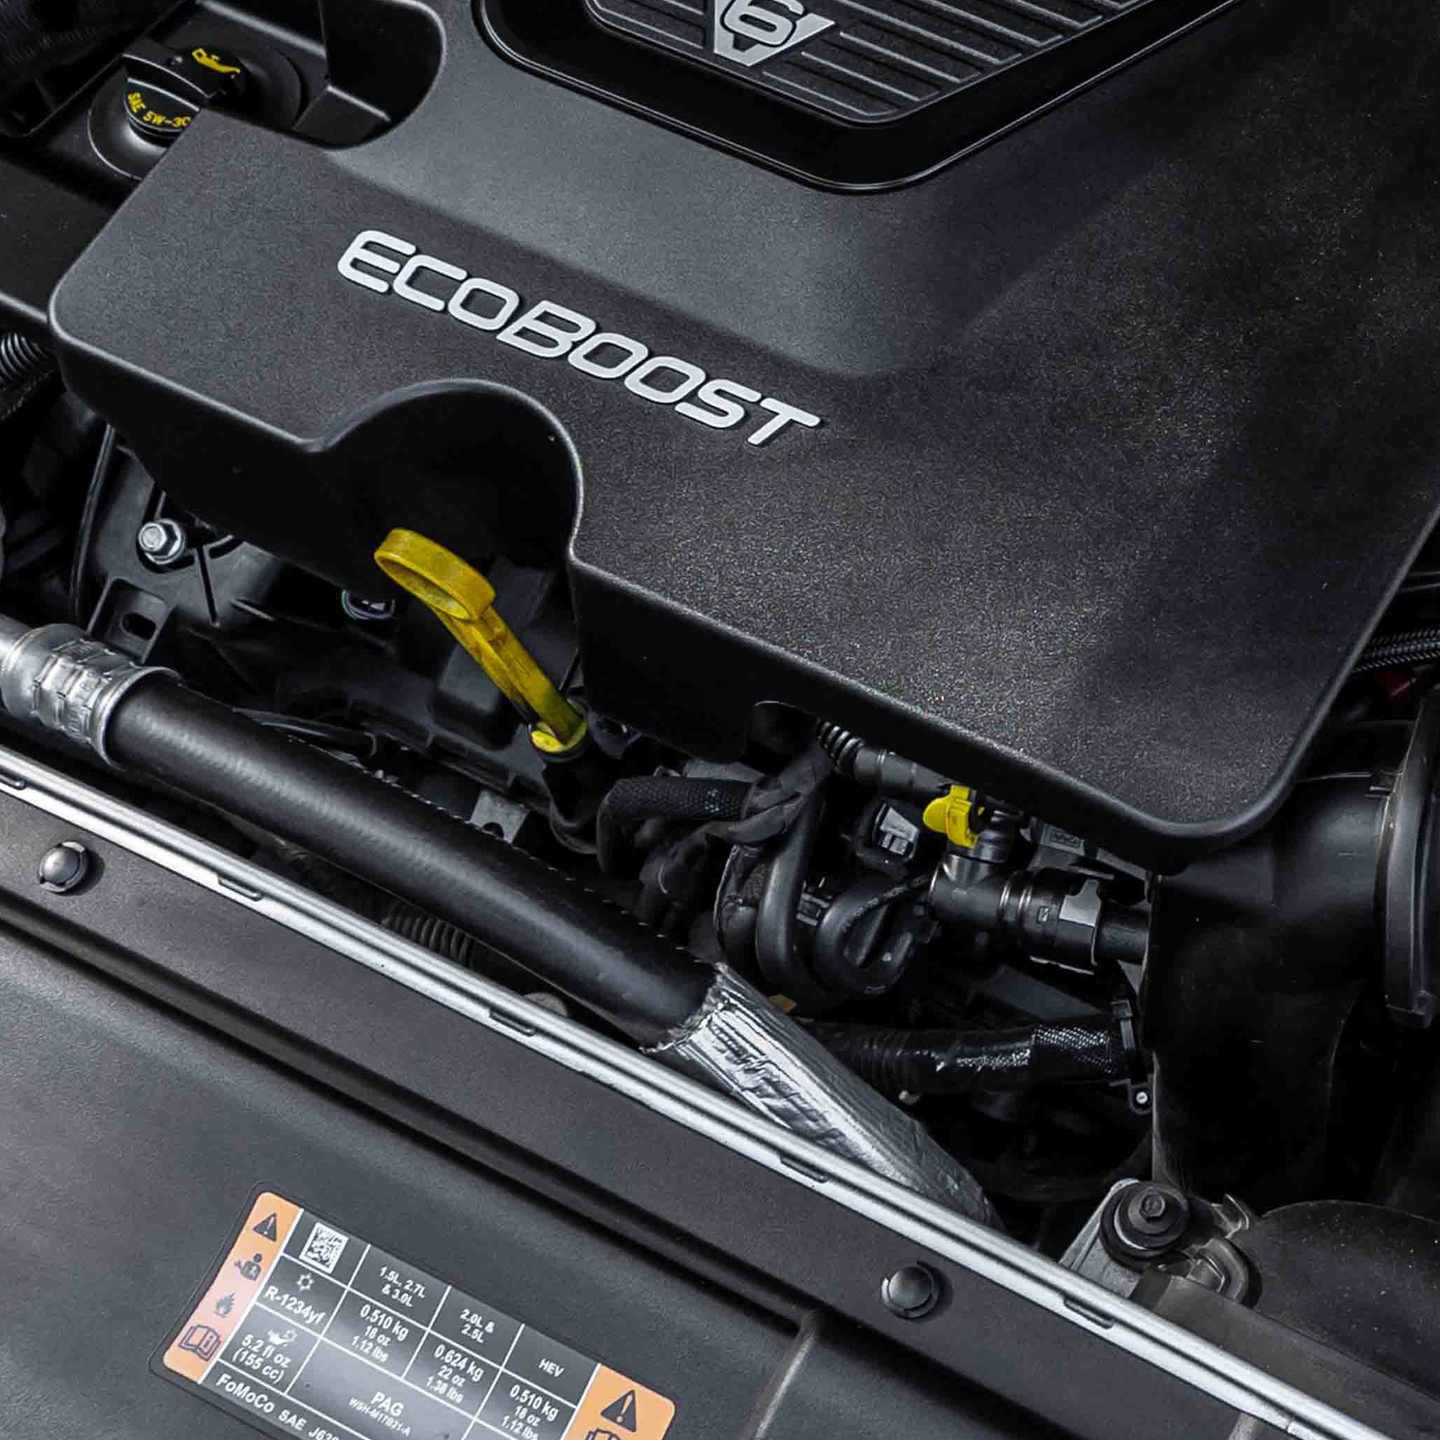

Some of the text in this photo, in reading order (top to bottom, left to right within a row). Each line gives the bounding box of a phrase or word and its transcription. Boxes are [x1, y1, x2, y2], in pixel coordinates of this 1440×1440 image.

[127, 91, 147, 114] SAE
[337, 230, 822, 447] ECOBOOST
[380, 1267, 425, 1298] 1.5L, 2.7L
[263, 1286, 325, 1324] R-1234yf
[392, 1289, 412, 1307] 3.0L
[392, 1321, 408, 1341] kg
[461, 1309, 494, 1333] 2.0L &
[365, 1326, 390, 1346] 18 oz
[462, 1324, 483, 1343] 2.5L
[242, 1334, 291, 1367] 5.2 fl oz
[371, 1346, 388, 1362] lbs
[233, 1348, 284, 1383] (155 cc)
[438, 1365, 465, 1387] 22 oz
[467, 1362, 484, 1382] kg
[539, 1359, 564, 1376] HEV
[216, 1374, 274, 1412] FoMoCo
[279, 1410, 306, 1430] SAE
[371, 1392, 403, 1416] PAG
[541, 1401, 559, 1424] kg
[515, 1406, 540, 1426] 18 oz
